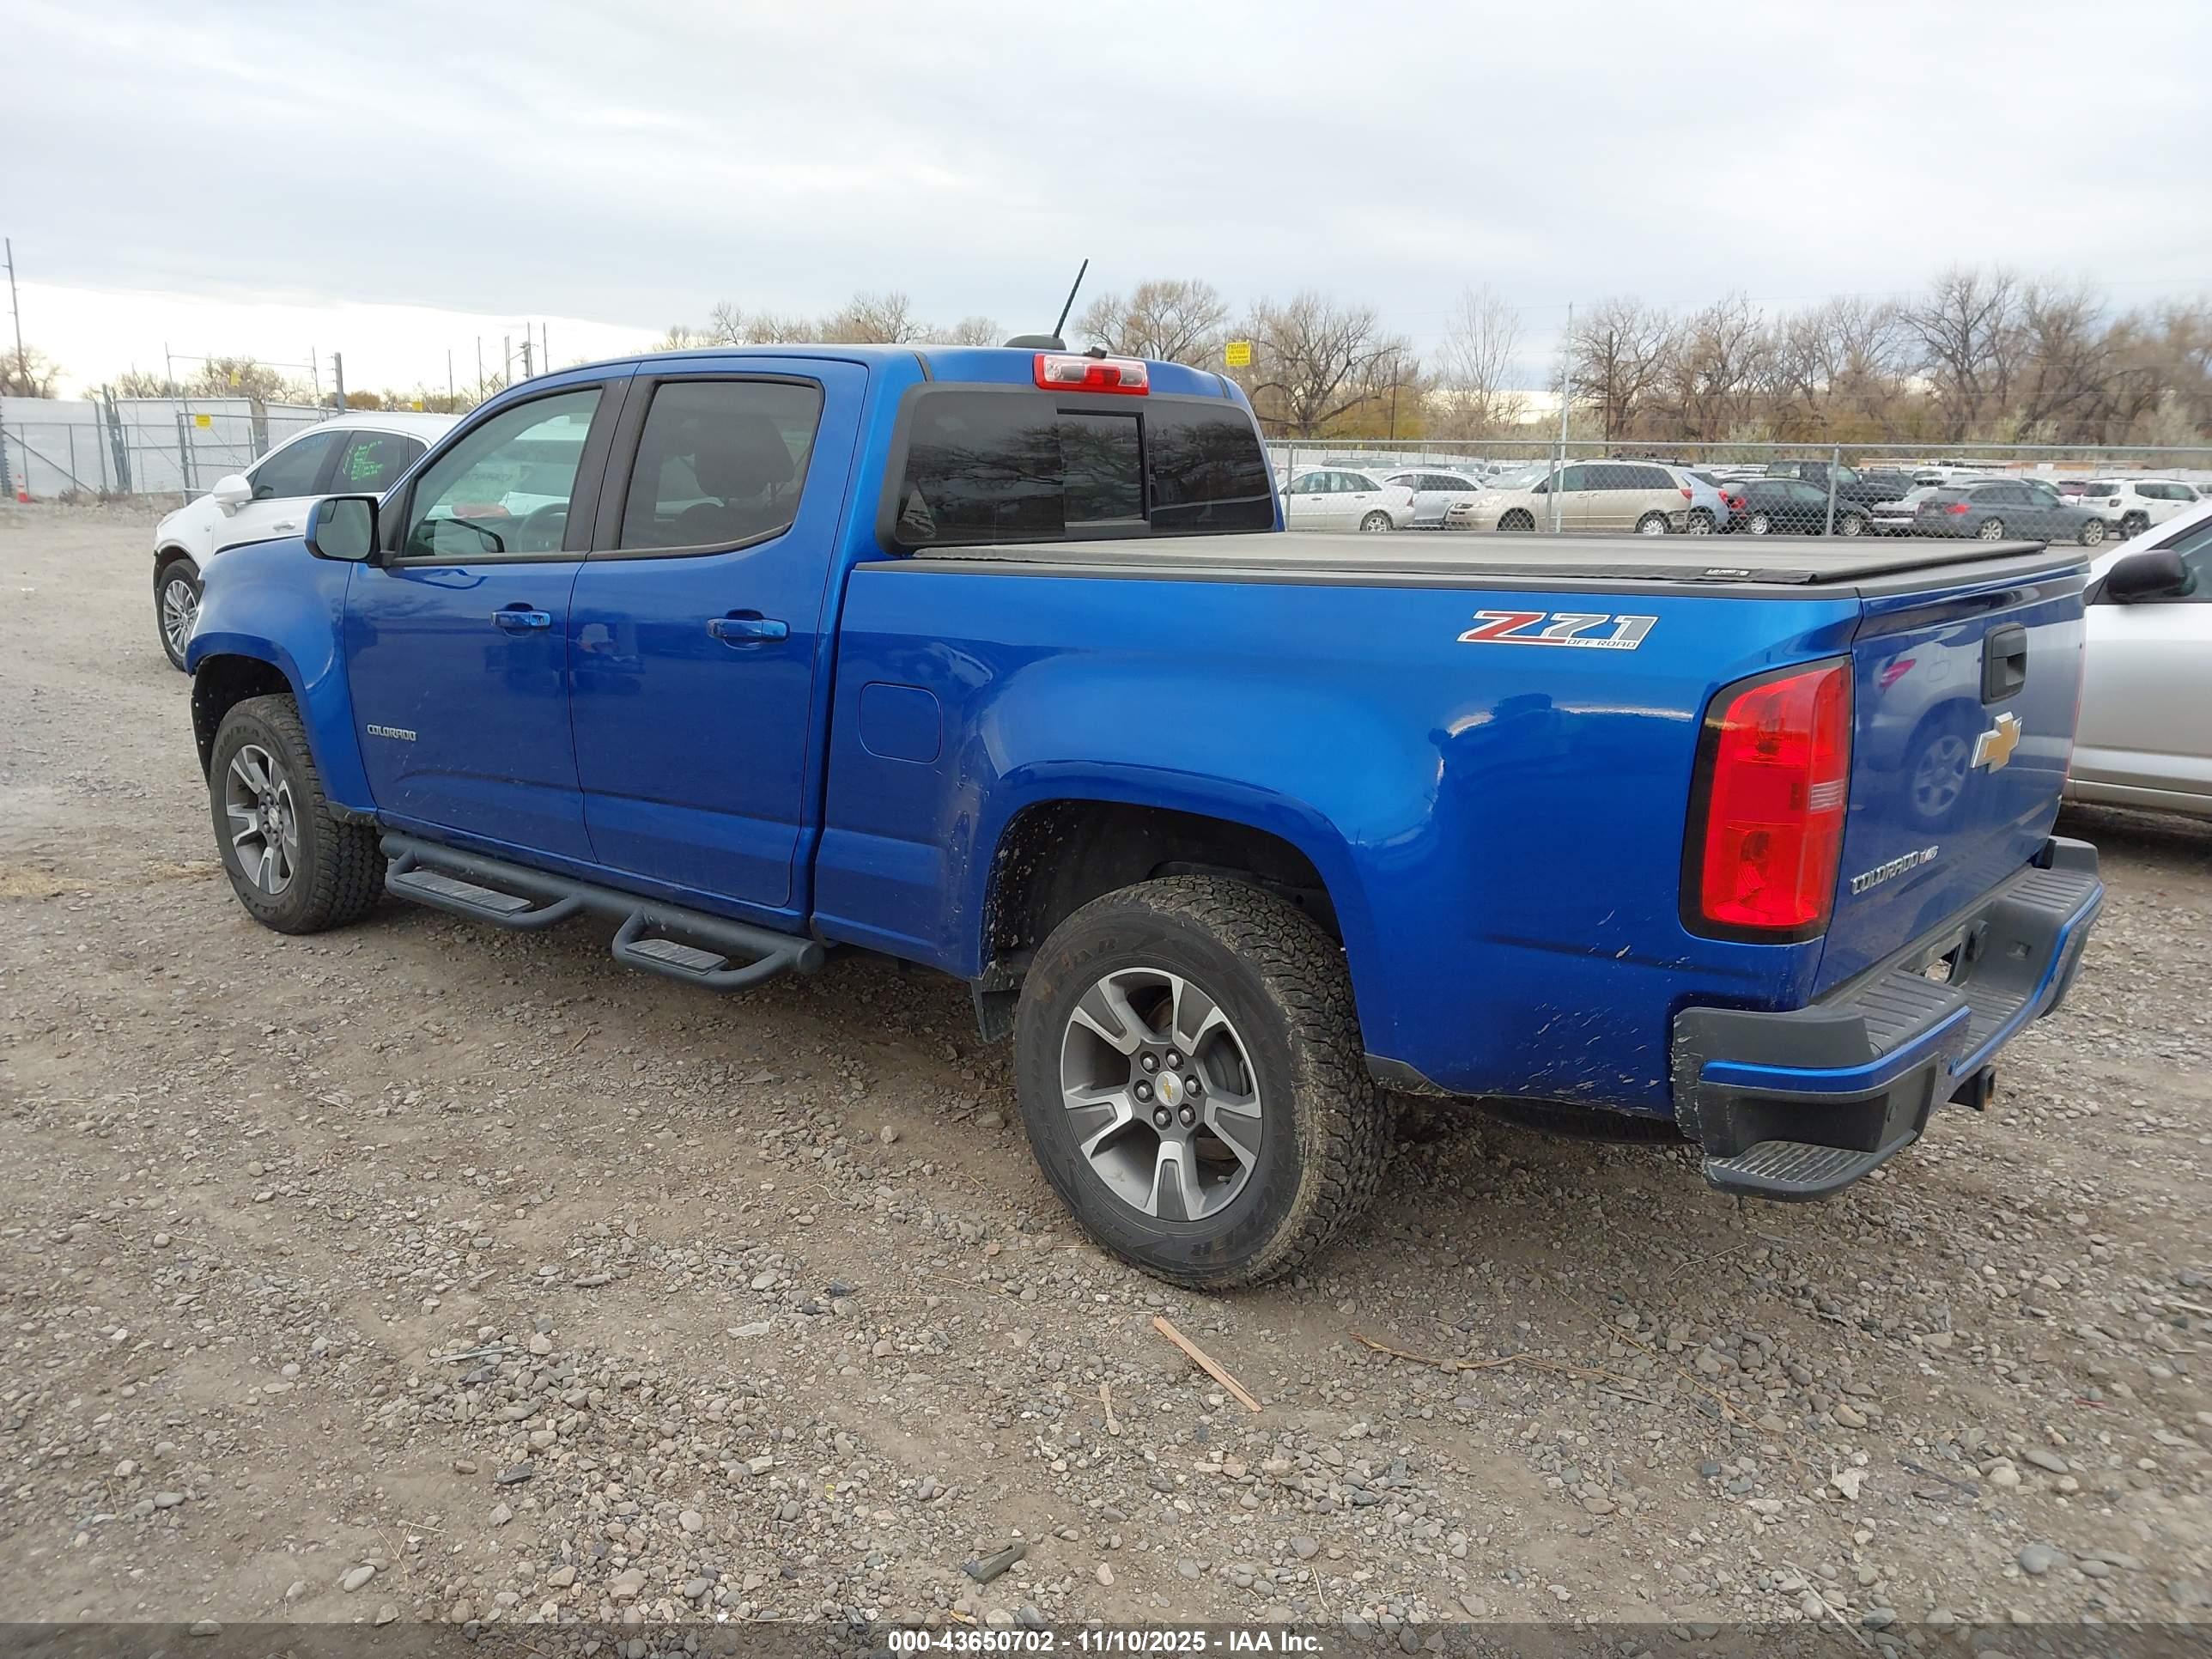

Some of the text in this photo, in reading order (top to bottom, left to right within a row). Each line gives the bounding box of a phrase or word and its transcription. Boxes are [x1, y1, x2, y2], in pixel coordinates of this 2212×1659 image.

[1457, 611, 1658, 647] Z71
[1597, 640, 1637, 648] ROAD
[367, 724, 416, 741] COLORADO
[1851, 851, 1919, 895] COLORADO
